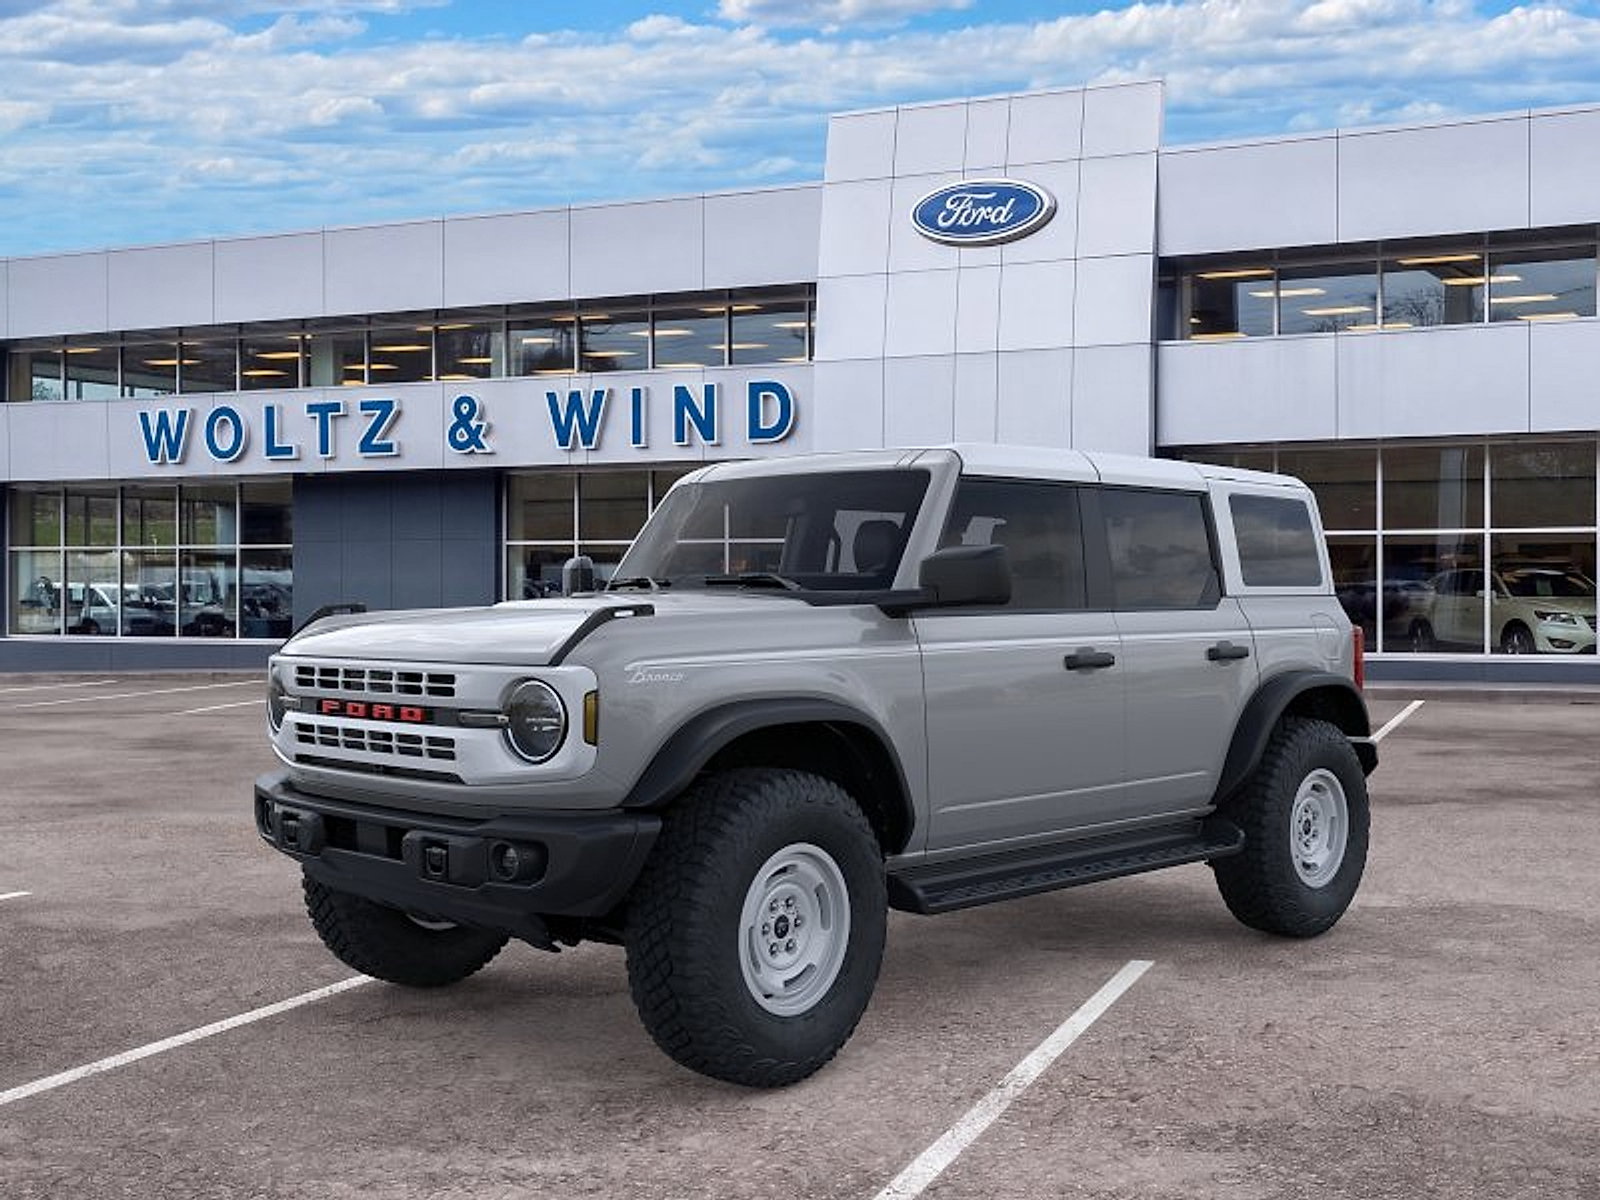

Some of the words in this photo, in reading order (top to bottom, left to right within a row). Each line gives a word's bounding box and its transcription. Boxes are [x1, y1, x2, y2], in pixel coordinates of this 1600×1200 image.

[937, 191, 1016, 228] Ford
[138, 399, 401, 464] WOLTZ
[447, 395, 492, 455] &
[545, 379, 795, 450] WIND
[321, 699, 424, 722] FORD
